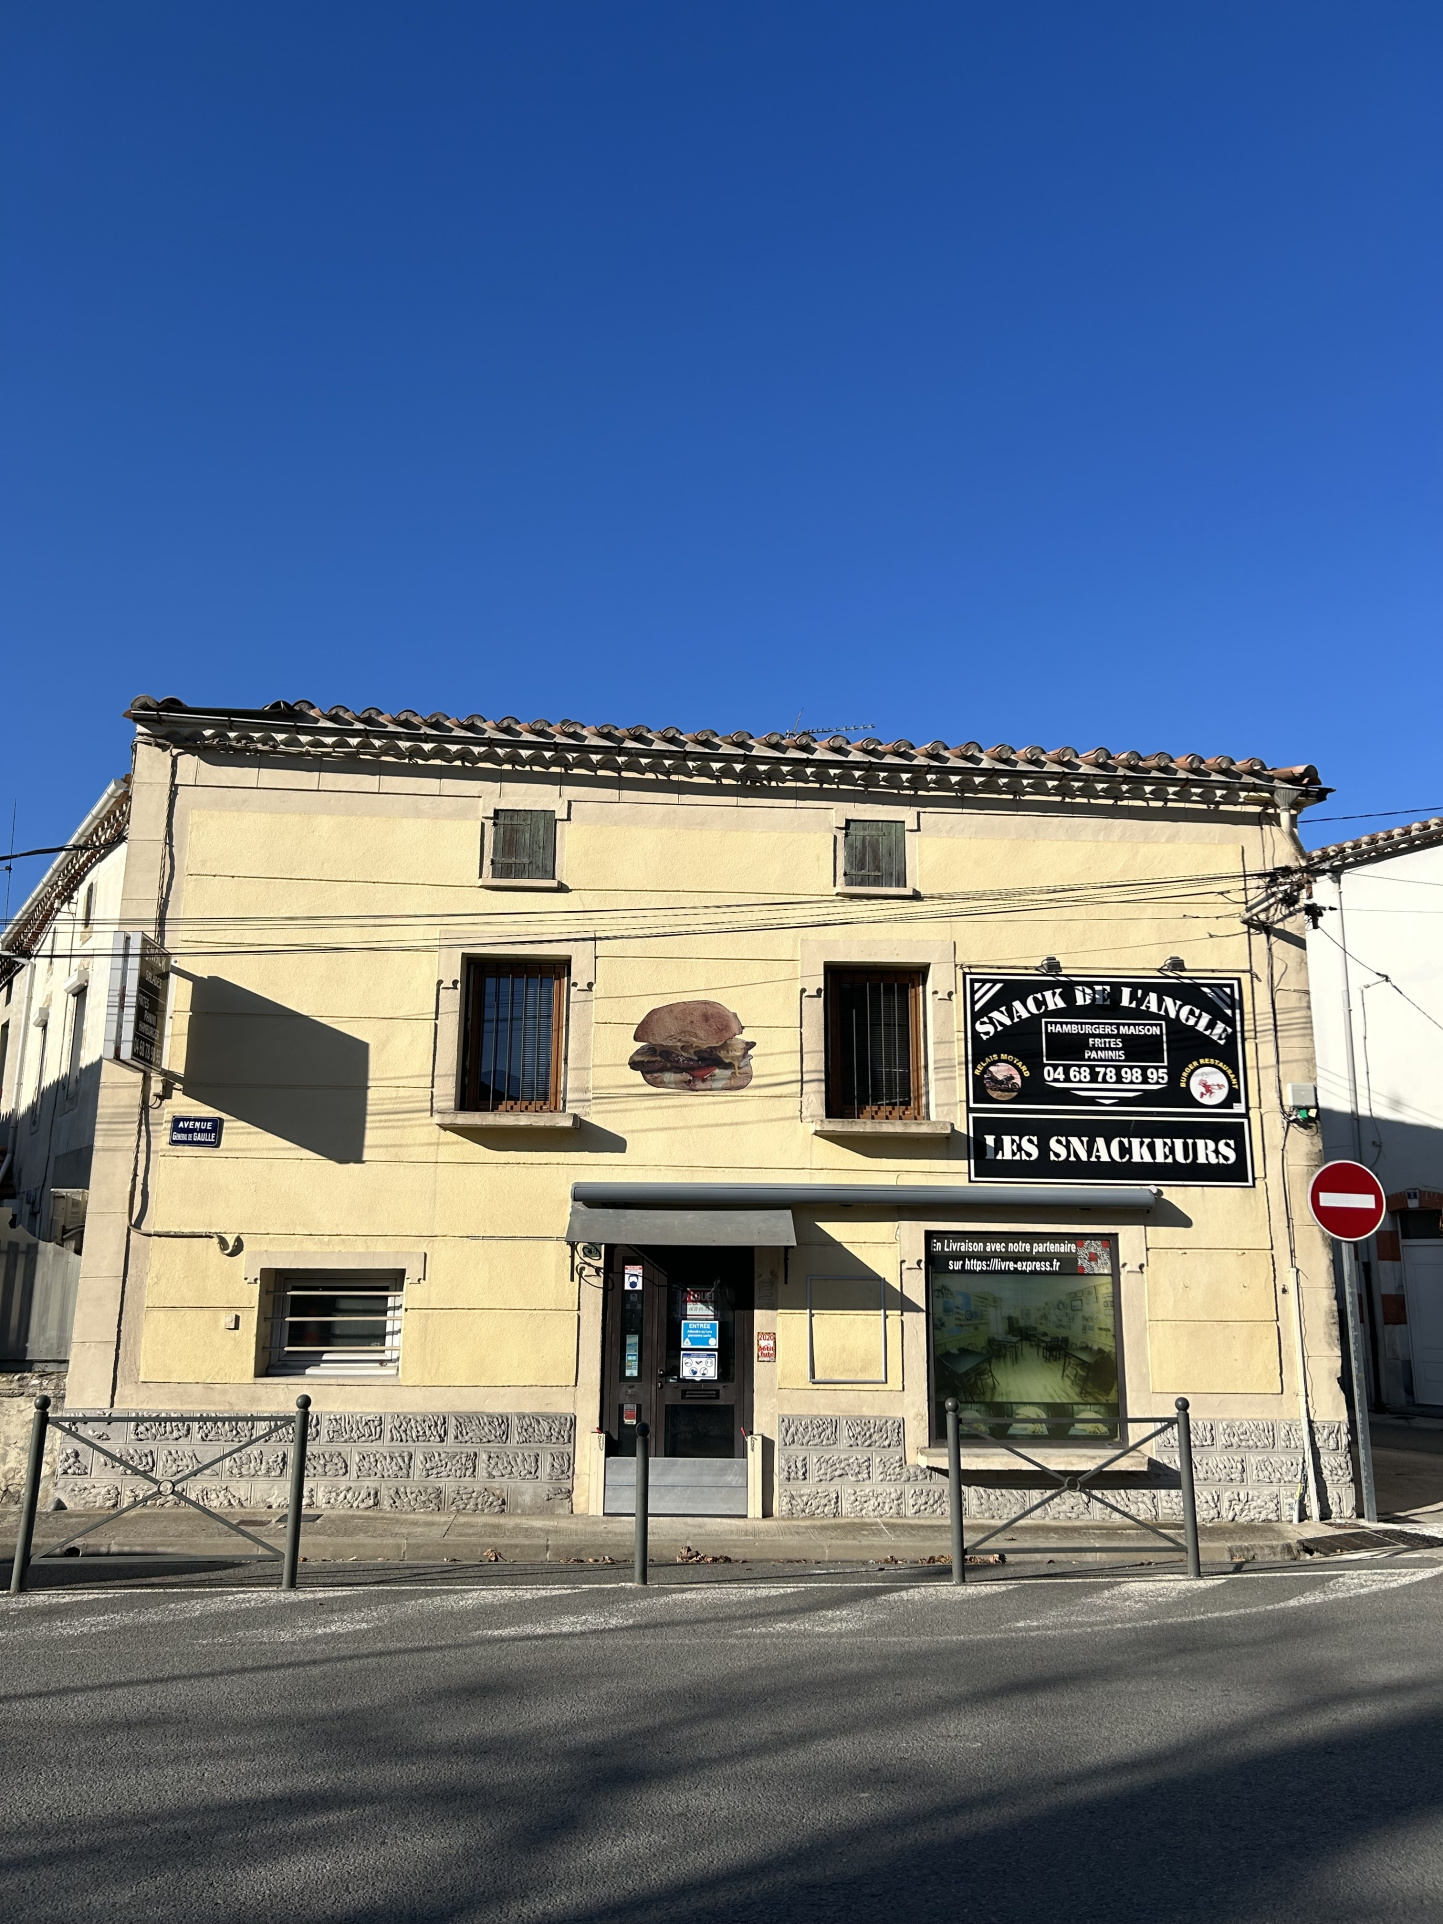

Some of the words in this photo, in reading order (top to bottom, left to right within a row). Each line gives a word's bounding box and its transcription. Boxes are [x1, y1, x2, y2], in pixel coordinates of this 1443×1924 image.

[974, 988, 1067, 1041] SNACK
[1074, 985, 1111, 1006] DE
[1119, 986, 1234, 1046] L'ANGLE
[1047, 1023, 1118, 1035] HAMBURGERS
[1119, 1024, 1161, 1036] MAISON
[1088, 1037, 1123, 1048] FRITES
[1084, 1049, 1125, 1060] PANINIS
[974, 1054, 999, 1076] RELAIS
[1000, 1053, 1030, 1077] MOTARD
[1043, 1066, 1065, 1082] 04
[1069, 1067, 1091, 1082] 68
[1095, 1067, 1117, 1083] 78
[1121, 1068, 1142, 1083] 98
[1147, 1068, 1169, 1084] 95
[1180, 1060, 1200, 1088] BURGER
[1199, 1058, 1239, 1090] RESTAURANT
[178, 1120, 213, 1130] AVENUE
[193, 1132, 216, 1142] GAULLE
[984, 1134, 1040, 1161] LES
[1049, 1135, 1237, 1165] SNACKEURS
[944, 1239, 984, 1252] Livraison
[985, 1242, 1006, 1252] avec
[1008, 1240, 1031, 1253] notre
[1032, 1240, 1076, 1255] partenaire
[948, 1260, 963, 1270] sur
[964, 1258, 1061, 1273] https://livre-express.fr
